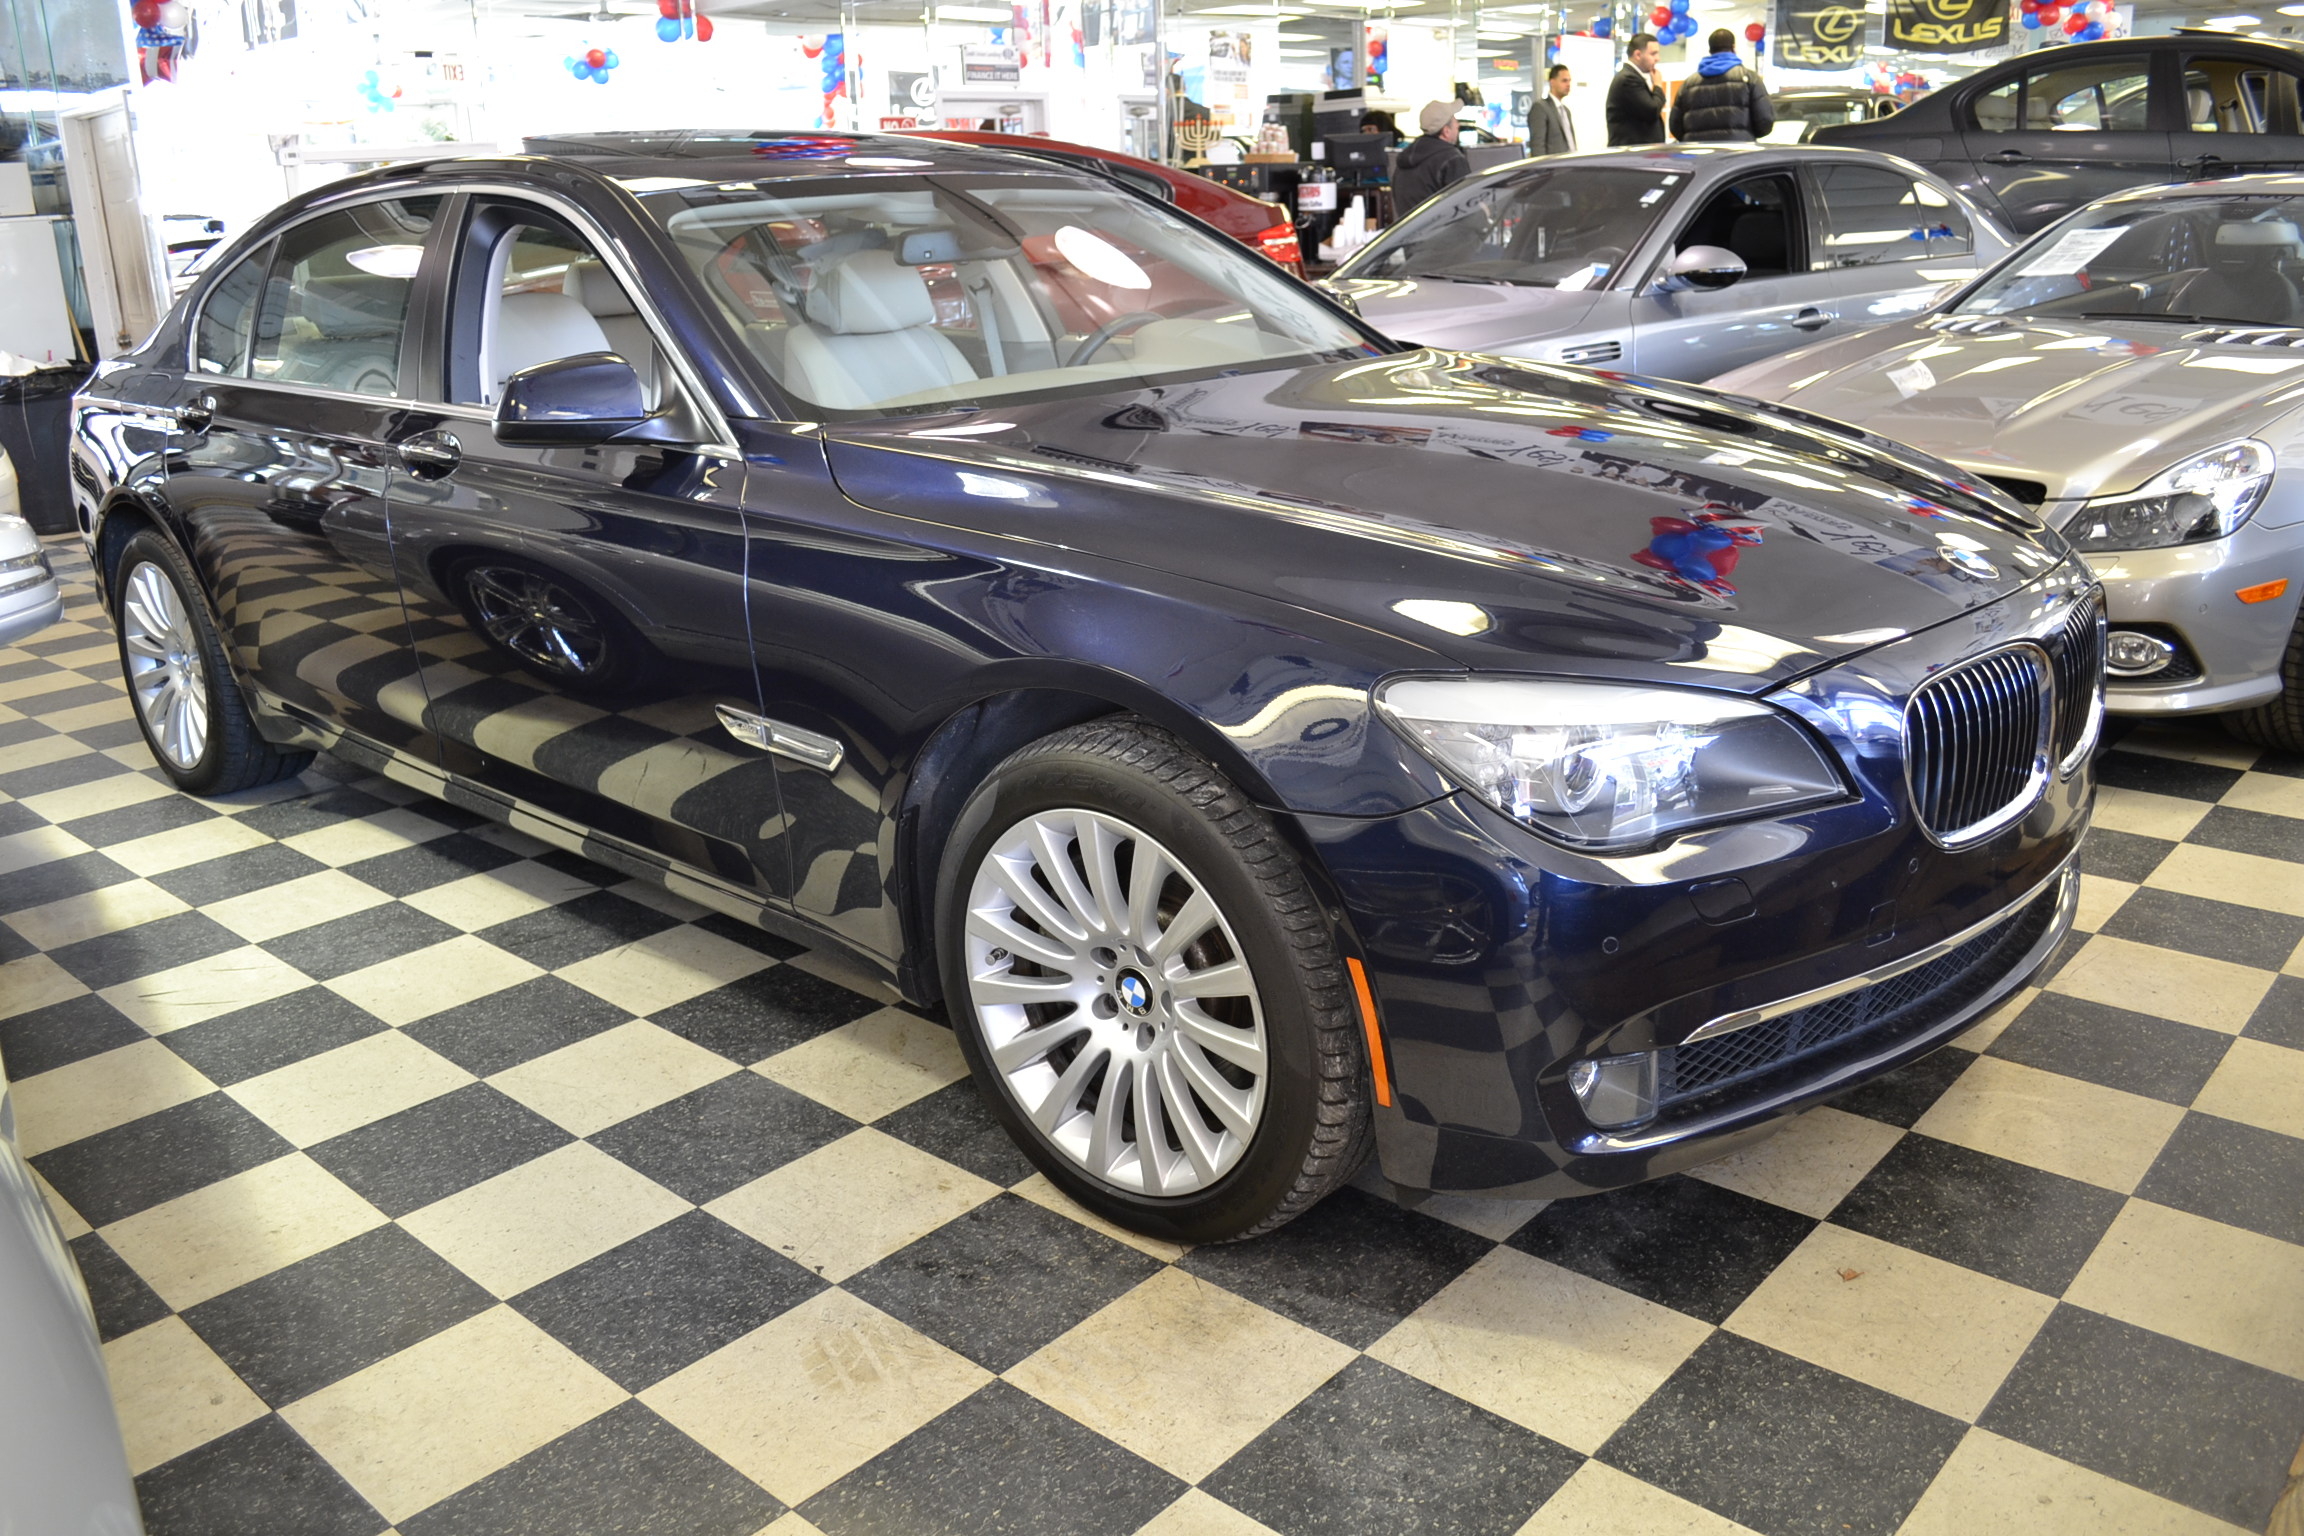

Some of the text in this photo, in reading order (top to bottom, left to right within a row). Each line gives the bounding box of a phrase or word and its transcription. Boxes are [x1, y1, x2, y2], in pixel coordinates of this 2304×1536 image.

[1893, 16, 2004, 44] LEXUS
[1783, 41, 1864, 64] LEXU
[1115, 989, 1147, 1016] BMW
